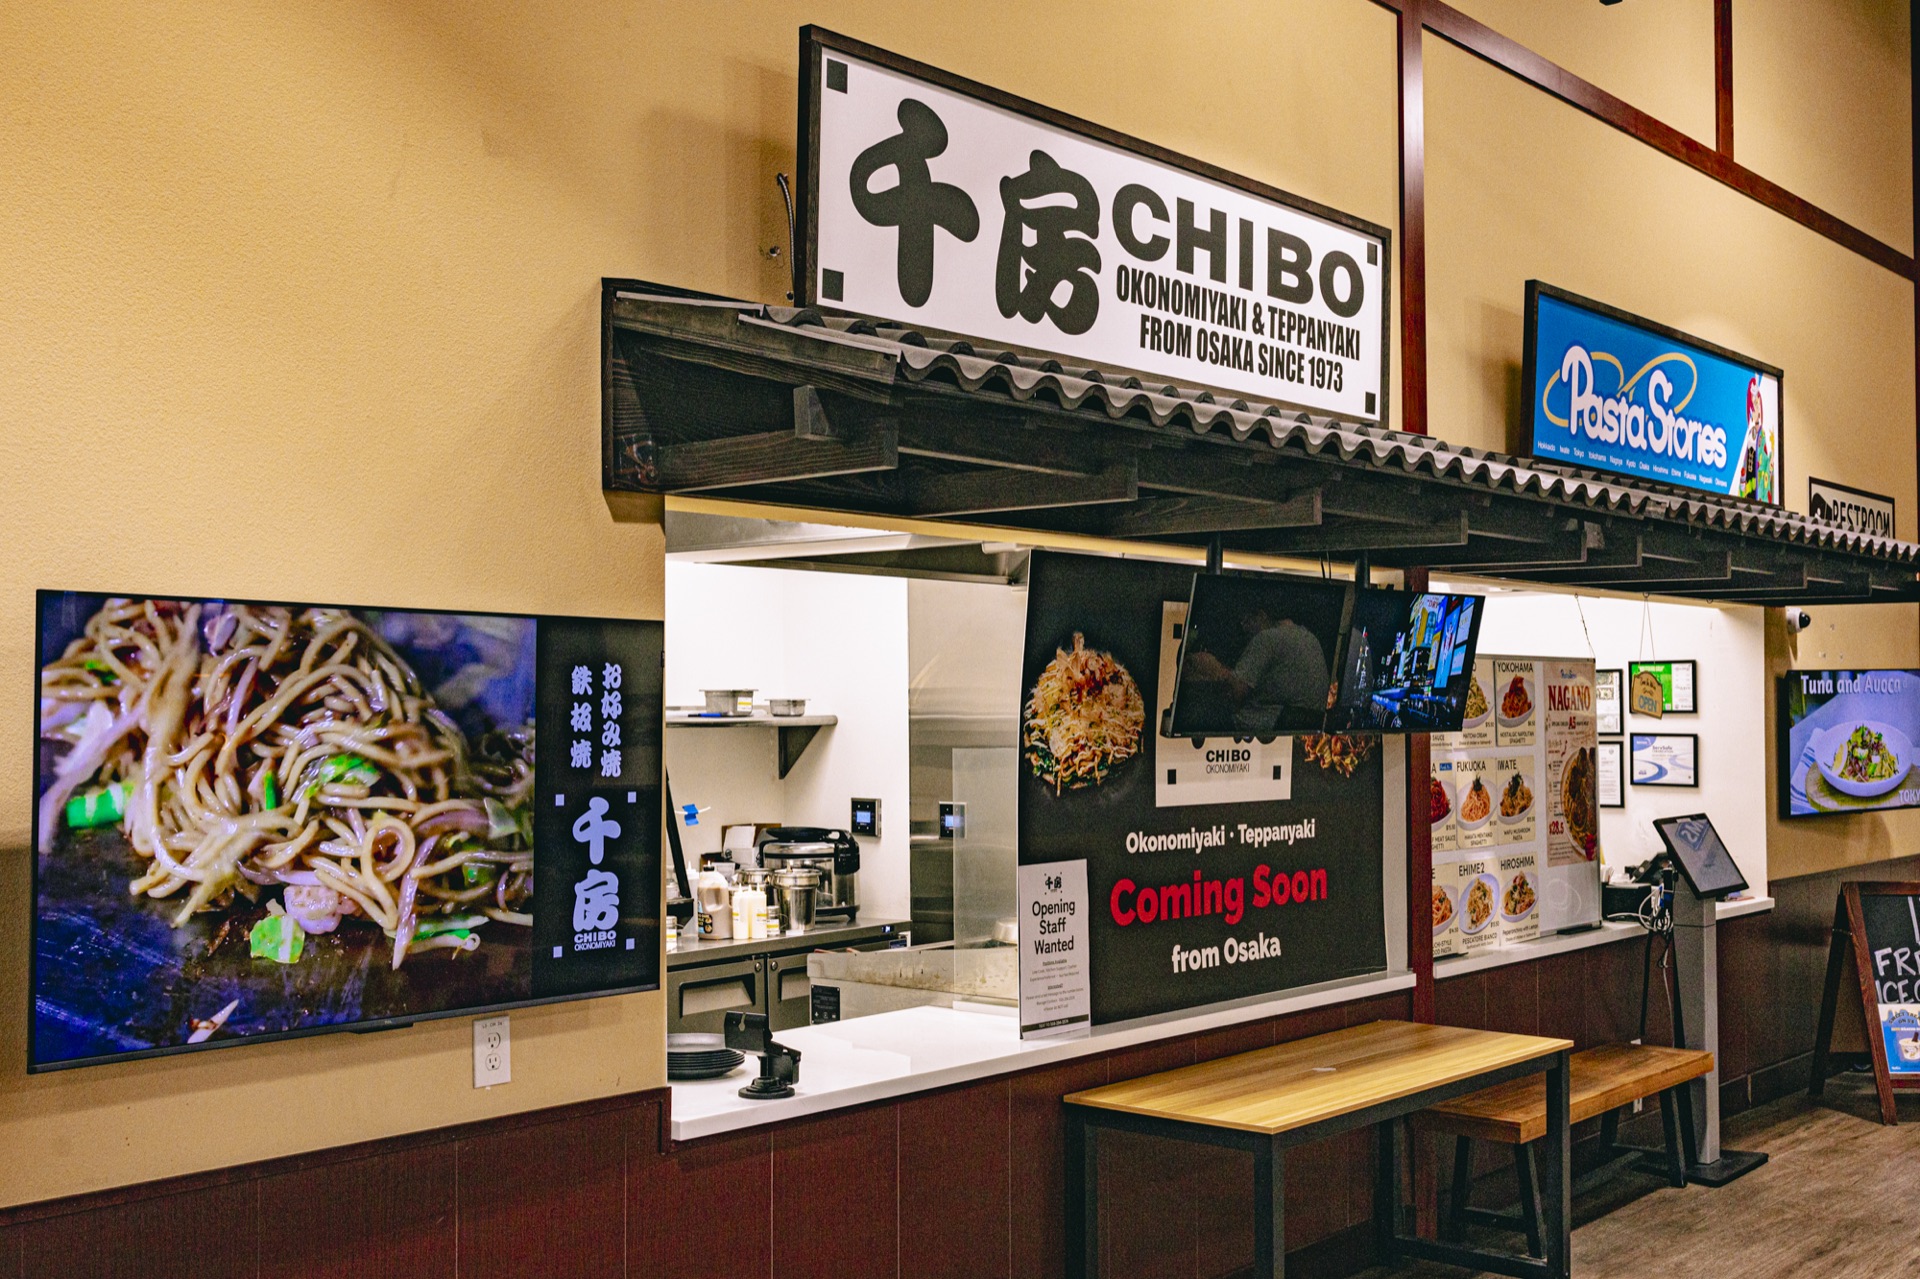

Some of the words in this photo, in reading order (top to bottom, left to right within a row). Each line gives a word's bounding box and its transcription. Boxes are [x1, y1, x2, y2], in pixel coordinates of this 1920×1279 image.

[849, 98, 1101, 335] 千房
[1112, 183, 1364, 318] CHIBO
[1116, 264, 1247, 335] OKONOMIYAKI
[1252, 313, 1265, 336] &
[1268, 308, 1361, 361] TEPPANYAKI
[1140, 314, 1192, 360] FROM
[1197, 332, 1253, 371] OSAKA
[1258, 346, 1305, 384] SINCE
[1308, 358, 1343, 393] 1973
[1561, 345, 1647, 450] Pasta
[1648, 369, 1727, 468] Stories
[1573, 447, 1584, 459] Tokyo
[1833, 498, 1890, 539] RESTROOM
[1497, 662, 1534, 673] YOKOHAMA
[1801, 675, 1833, 694] Tuna
[1837, 673, 1860, 694] and
[1548, 685, 1591, 711] NAGANO
[1638, 695, 1657, 713] OPEN
[571, 664, 592, 769] 鉄板焼
[601, 662, 622, 778] お好み焼
[1206, 749, 1251, 763] CHIBO
[1457, 760, 1487, 772] FUKUOKA
[1498, 759, 1517, 771] IWATE
[1206, 763, 1250, 774] OKONOMIYAKI
[1126, 825, 1225, 854] Okonomiyaki
[1238, 818, 1316, 847] Teppanyaki
[1445, 834, 1456, 842] SAUCE
[572, 796, 621, 932] 千房
[1458, 862, 1485, 876] EHIME2
[1500, 856, 1535, 871] HIROSHIMA
[1110, 870, 1244, 926] Coming
[1252, 864, 1328, 908] Soon
[1032, 899, 1076, 919] Opening
[1039, 917, 1066, 935] Staff
[574, 930, 617, 943] CHIBO
[574, 939, 616, 951] OKONOMIYAKI
[1034, 935, 1074, 955] Wanted
[1172, 941, 1220, 973] from
[1223, 932, 1281, 964] Osaka
